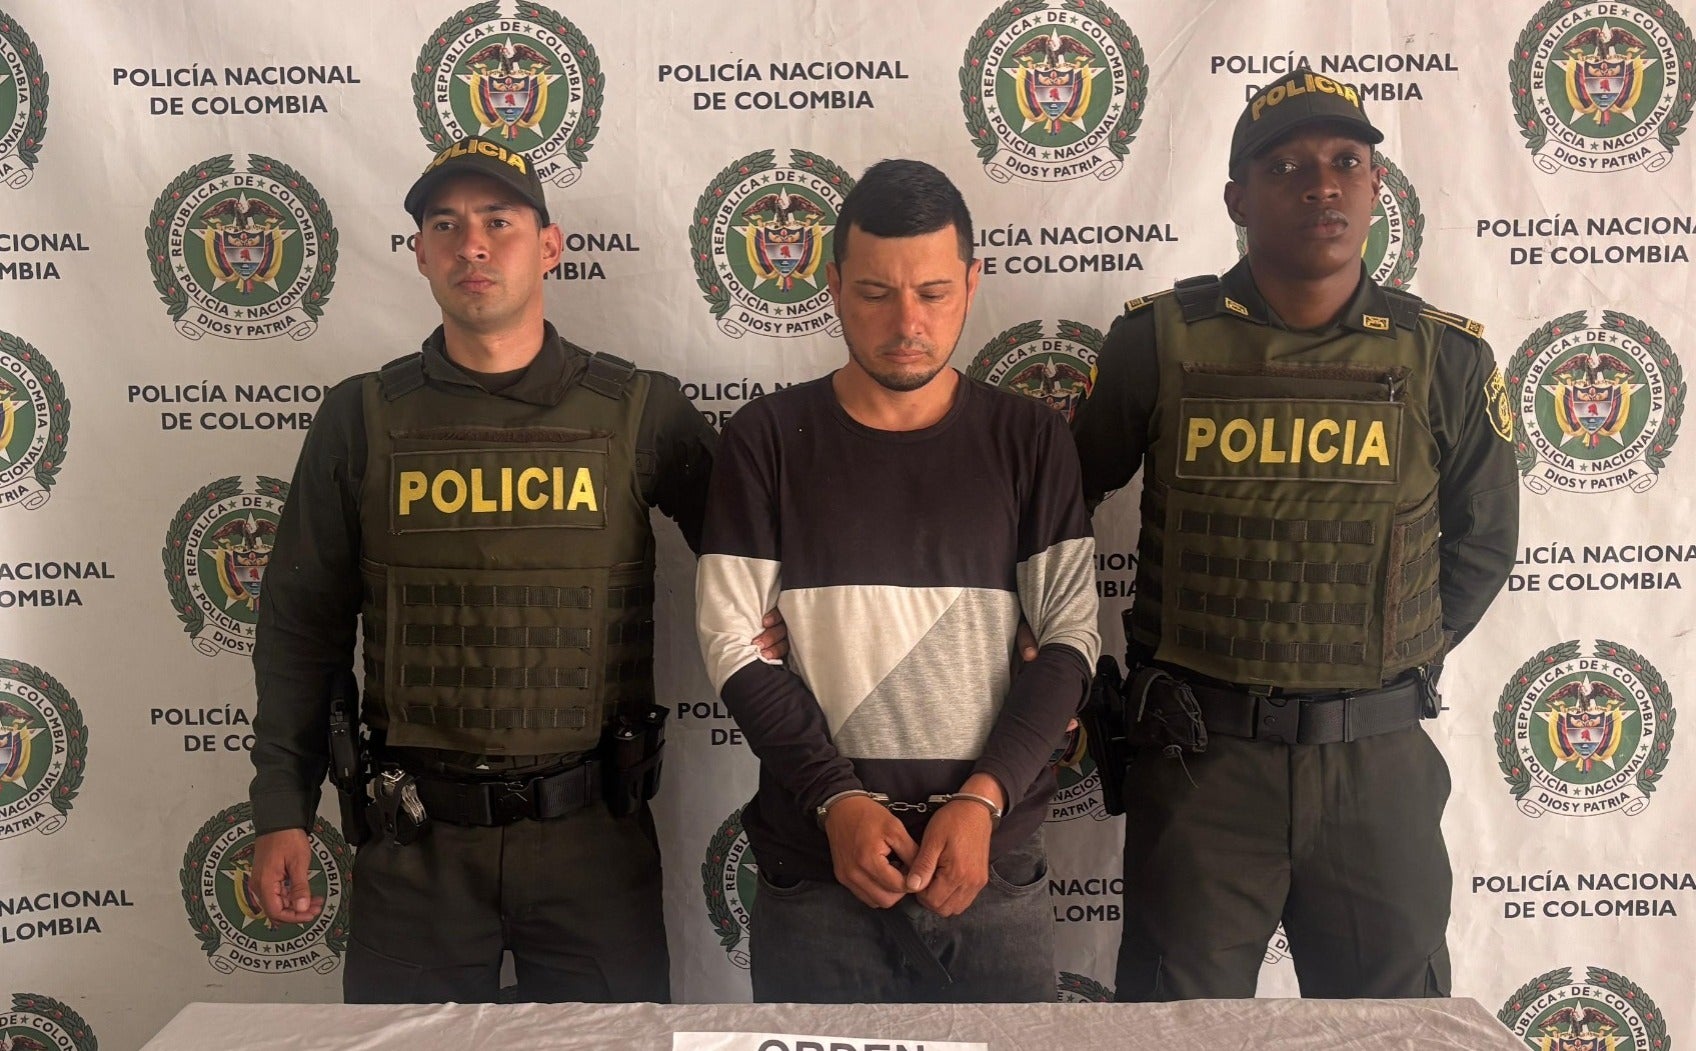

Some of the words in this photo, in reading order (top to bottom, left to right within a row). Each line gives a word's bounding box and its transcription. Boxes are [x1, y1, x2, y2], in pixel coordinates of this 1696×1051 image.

[1047, 11, 1067, 23] DE
[1082, 20, 1125, 96] COLOMBIA
[1598, 4, 1618, 15] DE
[1633, 13, 1676, 88] COLOMBIA
[0, 36, 28, 103] LOMBIA
[500, 21, 520, 32] DE
[536, 29, 581, 102] COLOMBIA
[657, 59, 762, 83] POLICÍA
[769, 60, 909, 81] NACIONAL
[1321, 54, 1459, 73] NACIONAL
[113, 63, 217, 87] POLICÍA
[224, 66, 361, 86] NACIONAL
[150, 97, 184, 116] DE
[191, 95, 328, 116] COLOMBIA
[693, 92, 727, 111] DE
[735, 90, 875, 110] COLOMBIA
[1251, 73, 1359, 121] POLICIA
[1054, 113, 1117, 159] NACIONAL
[1603, 104, 1669, 151] NACIONAL
[1053, 155, 1103, 177] PATRIA
[1602, 147, 1651, 169] PATRIA
[776, 171, 795, 182] DE
[234, 175, 254, 186] DE
[269, 185, 316, 258] COLOMBIA
[1477, 213, 1579, 237] POLICÍA
[1040, 223, 1178, 246] NACIONAL
[1005, 253, 1144, 274] COLOMBIA
[1510, 247, 1543, 265] DE
[1550, 245, 1689, 264] COLOMBIA
[247, 273, 311, 319] NACIONAL
[247, 315, 297, 336] PATRIA
[738, 312, 773, 333] DIOS
[786, 312, 833, 334] PATRIA
[1042, 341, 1062, 351] DE
[1586, 331, 1606, 341] DE
[1621, 339, 1662, 411] COLOMBIA
[0, 356, 48, 428] COLOMBIA
[128, 380, 227, 403] POLICÍA
[235, 385, 327, 402] NACIO
[161, 413, 192, 430] DE
[1185, 417, 1390, 466] POLICIA
[1591, 427, 1656, 472] NACIONAL
[0, 445, 43, 486] CIONAL
[1590, 468, 1638, 489] PATRIA
[242, 497, 262, 507] DE
[398, 467, 598, 516] POLICIA
[1508, 574, 1541, 592] DE
[1547, 572, 1682, 591] COLOMBIA
[212, 631, 245, 651] DIOS
[1579, 659, 1598, 670] DE
[1613, 667, 1653, 737] COLOMBIA
[17, 685, 65, 754] COLOMBIA
[150, 704, 250, 726] POLICÍA
[184, 735, 216, 752] DE
[711, 728, 742, 746] DE
[1585, 752, 1646, 796] NACIONAL
[1052, 797, 1098, 819] PATRIA
[1583, 792, 1631, 813] PATRIA
[1472, 870, 1570, 893] POLICÍA
[0, 890, 134, 917] NACIONAL
[1504, 901, 1535, 918] DE
[1543, 900, 1677, 917] COLOMBIA
[275, 911, 334, 954] NACIONAL
[275, 950, 321, 970] PATRIA
[1571, 986, 1590, 996] DE
